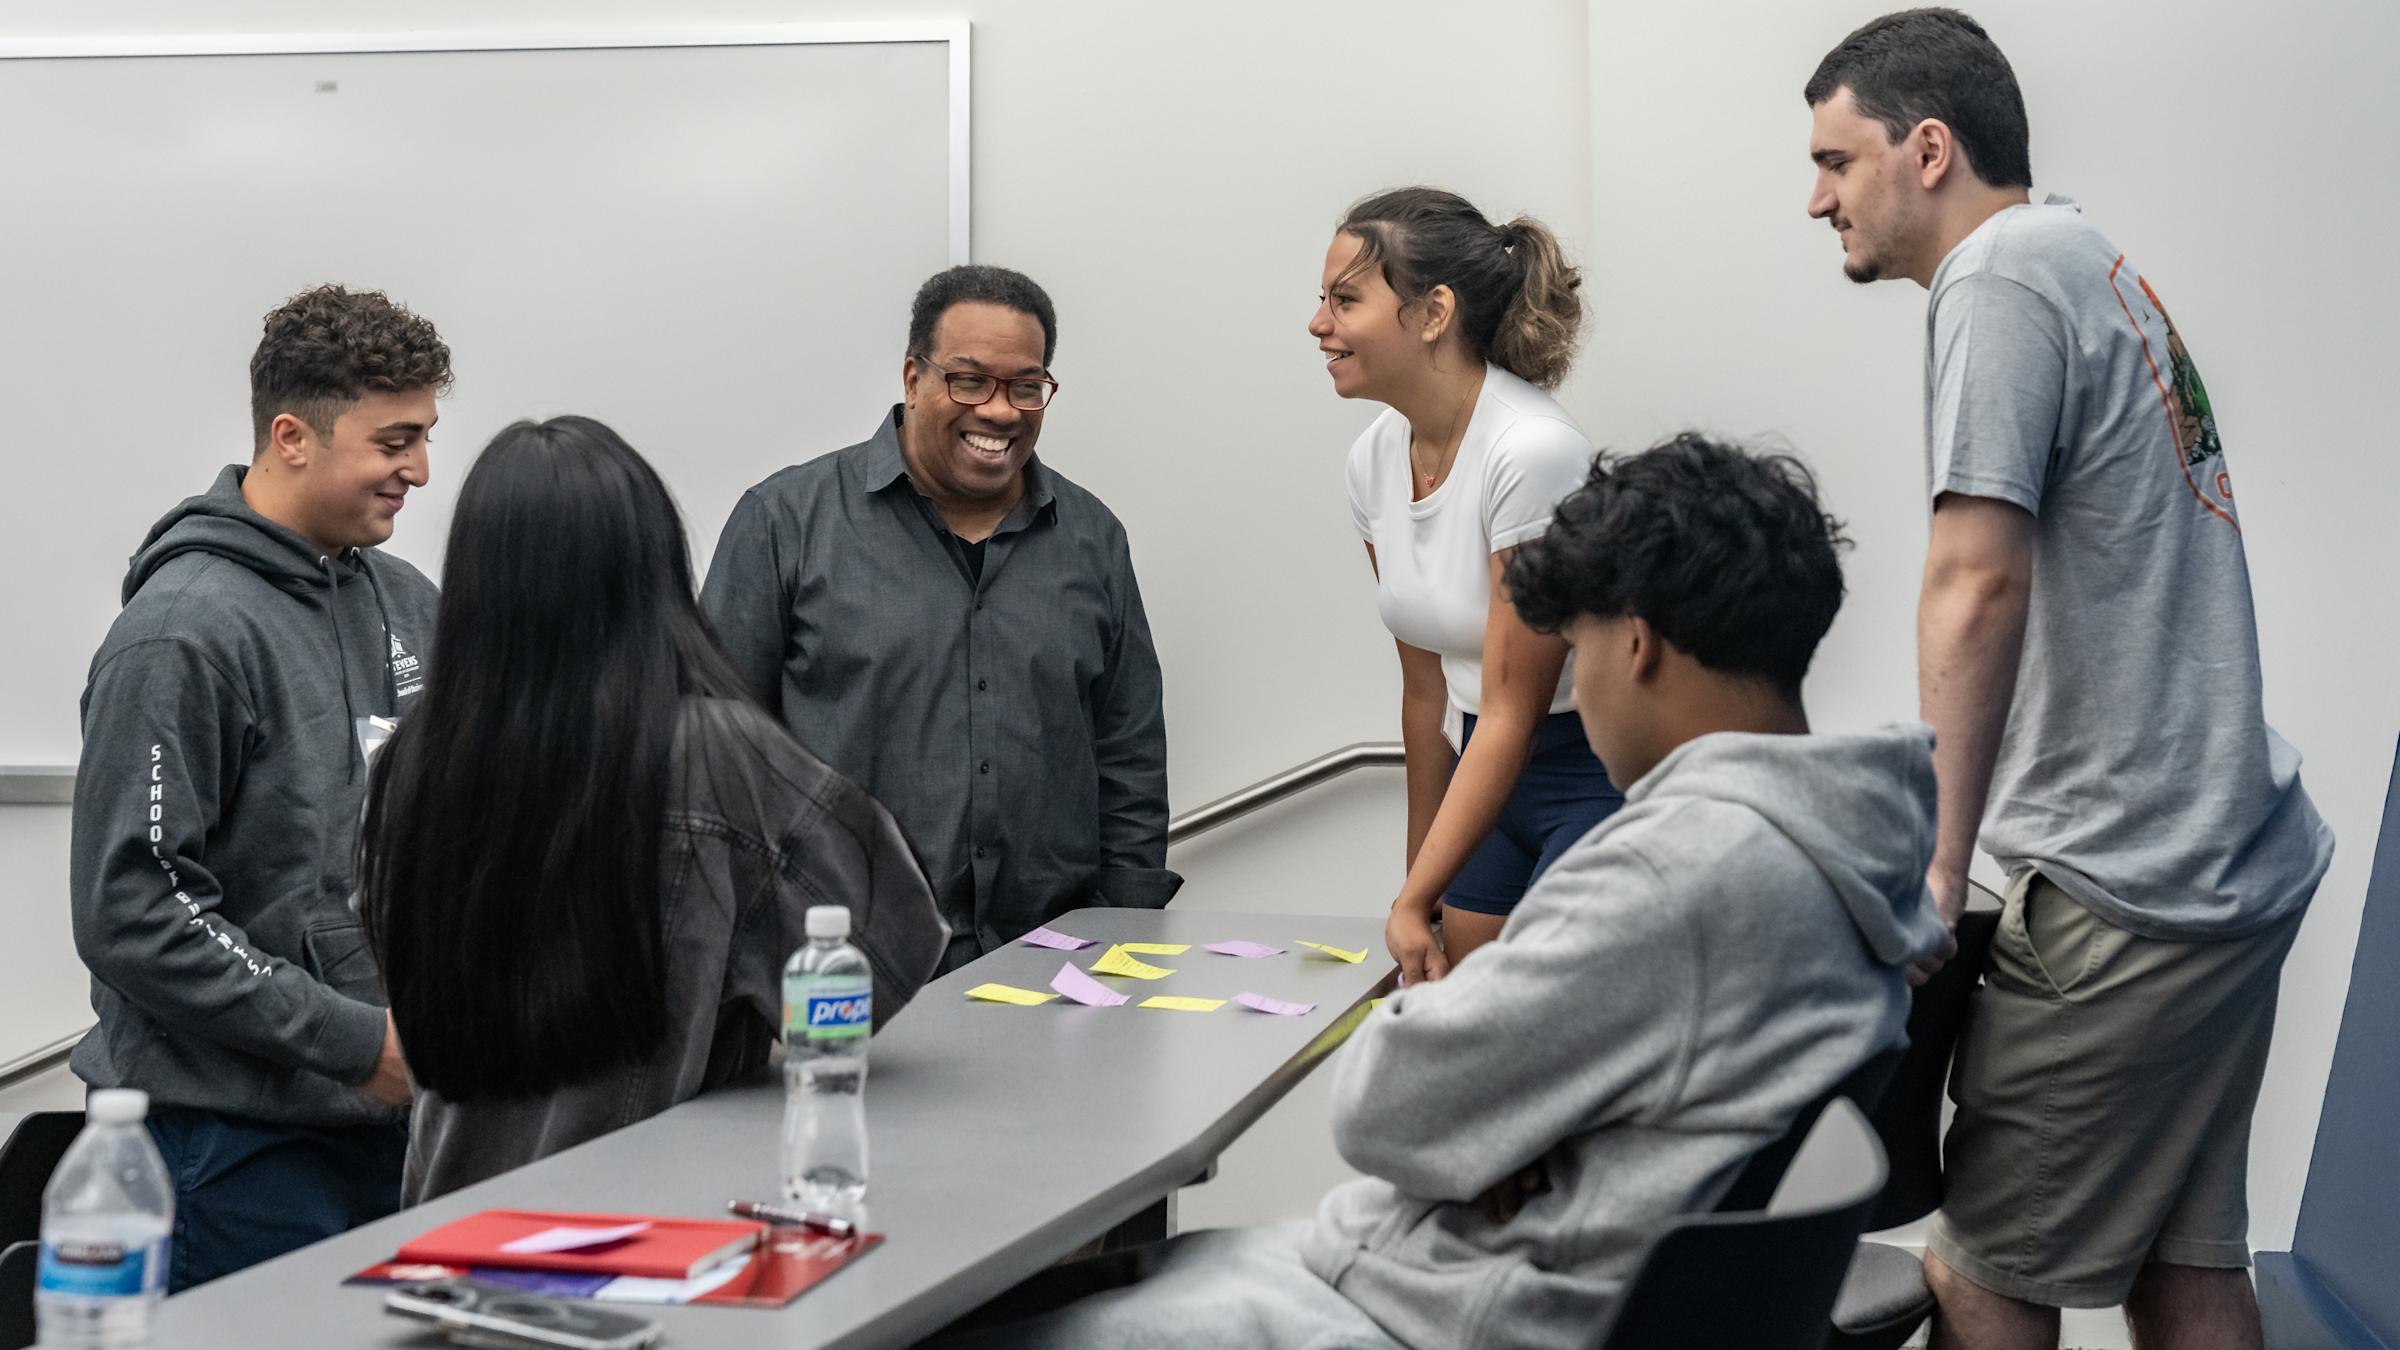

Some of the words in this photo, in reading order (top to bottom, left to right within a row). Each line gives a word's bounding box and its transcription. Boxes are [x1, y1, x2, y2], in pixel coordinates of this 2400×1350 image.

[385, 655, 418, 672] TEVENS
[149, 744, 163, 858] SCHOOL
[811, 996, 870, 1027] prop
